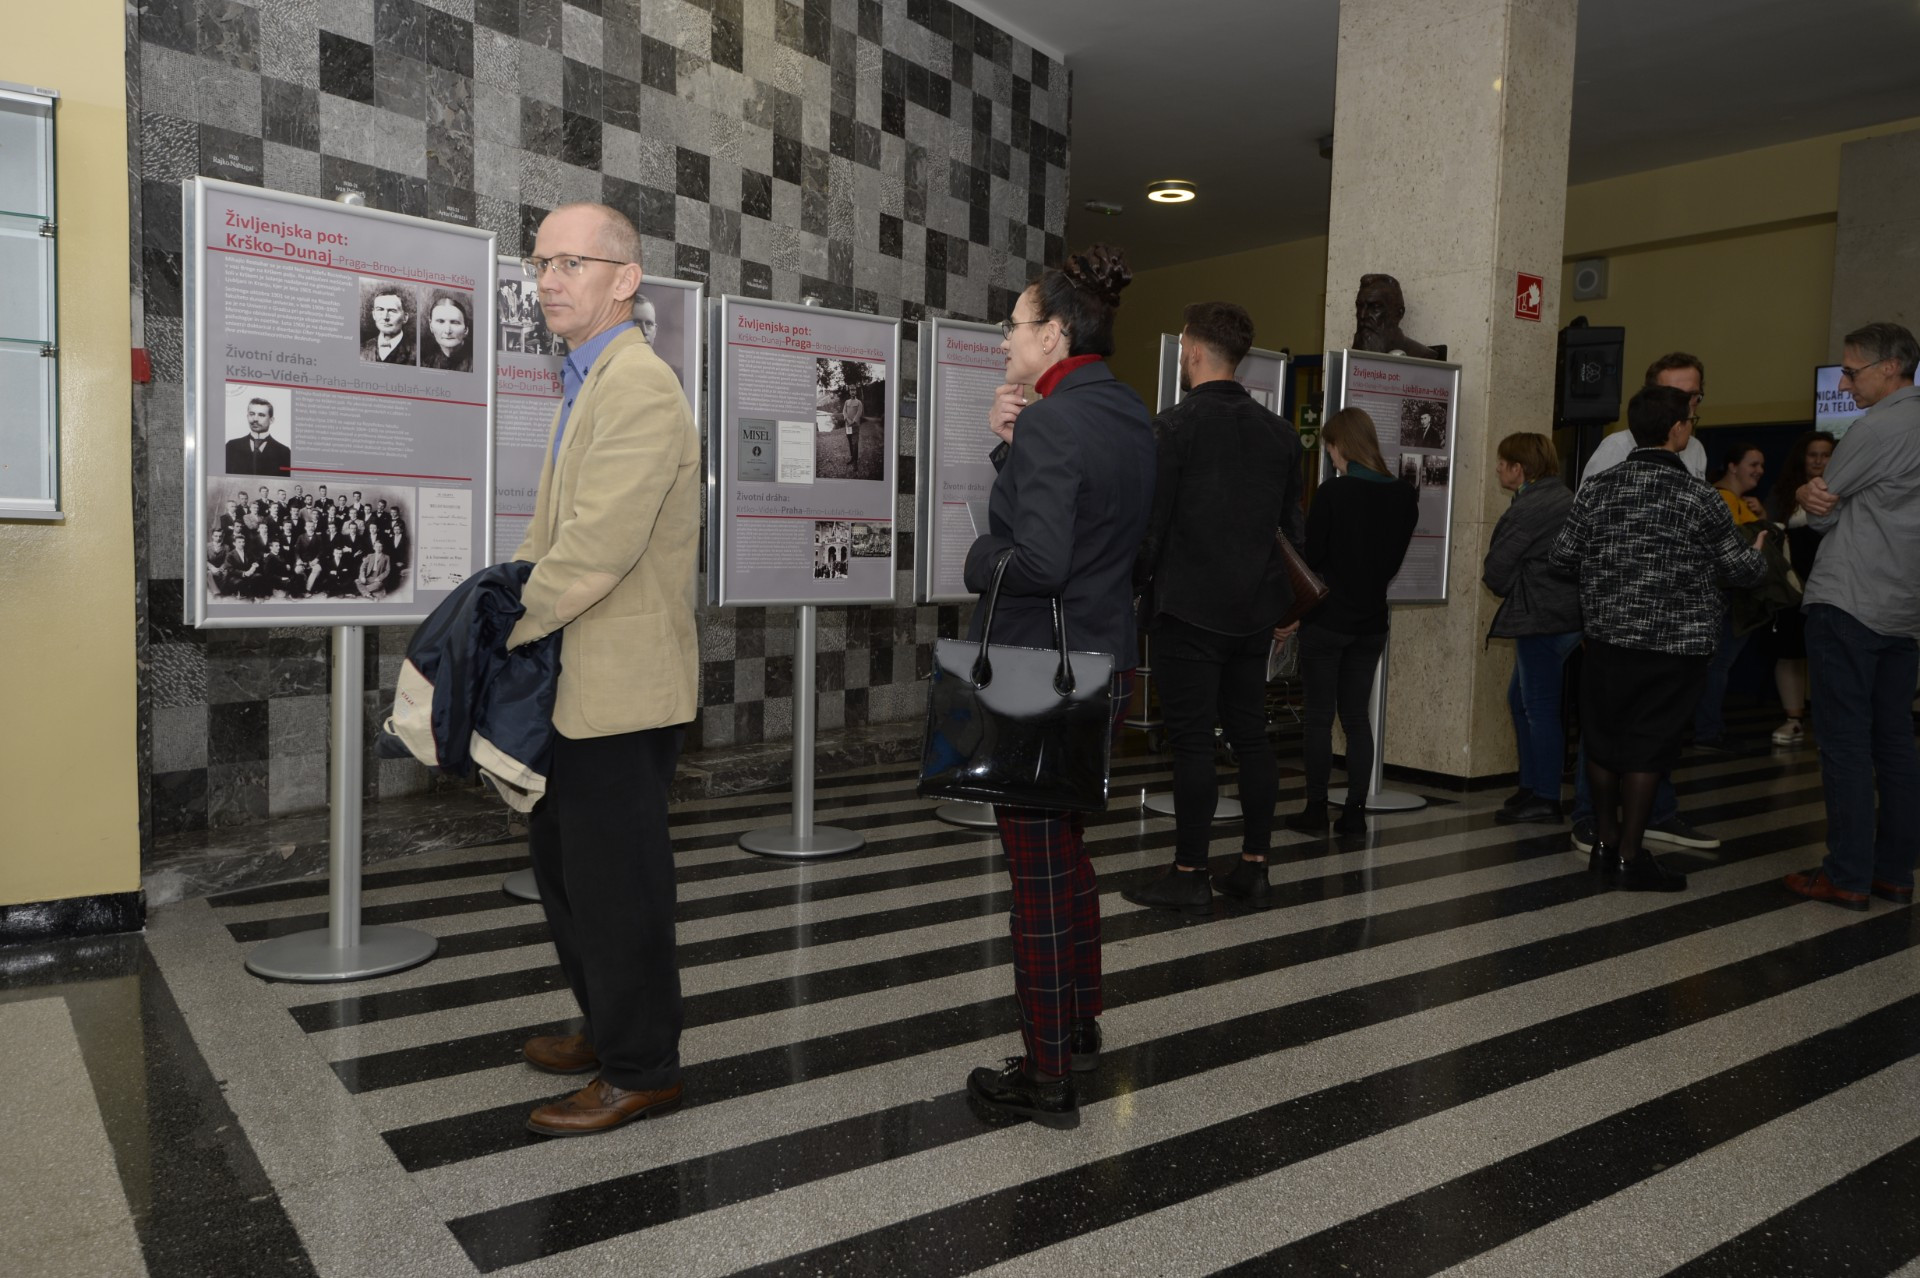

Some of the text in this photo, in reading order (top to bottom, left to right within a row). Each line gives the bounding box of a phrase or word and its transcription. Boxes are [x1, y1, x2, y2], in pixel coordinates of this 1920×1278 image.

[225, 208, 349, 247] Življenjska pot:
[738, 315, 812, 337] Življenjska pot:
[947, 338, 988, 353] Življenjska
[226, 343, 317, 367] Životní dráha:
[496, 364, 557, 381] ivljenjska
[1353, 366, 1387, 380] Življenjska
[1818, 401, 1858, 413] ZA TELO.
[743, 429, 771, 441] MISEL
[736, 491, 790, 502] Životní dráha:
